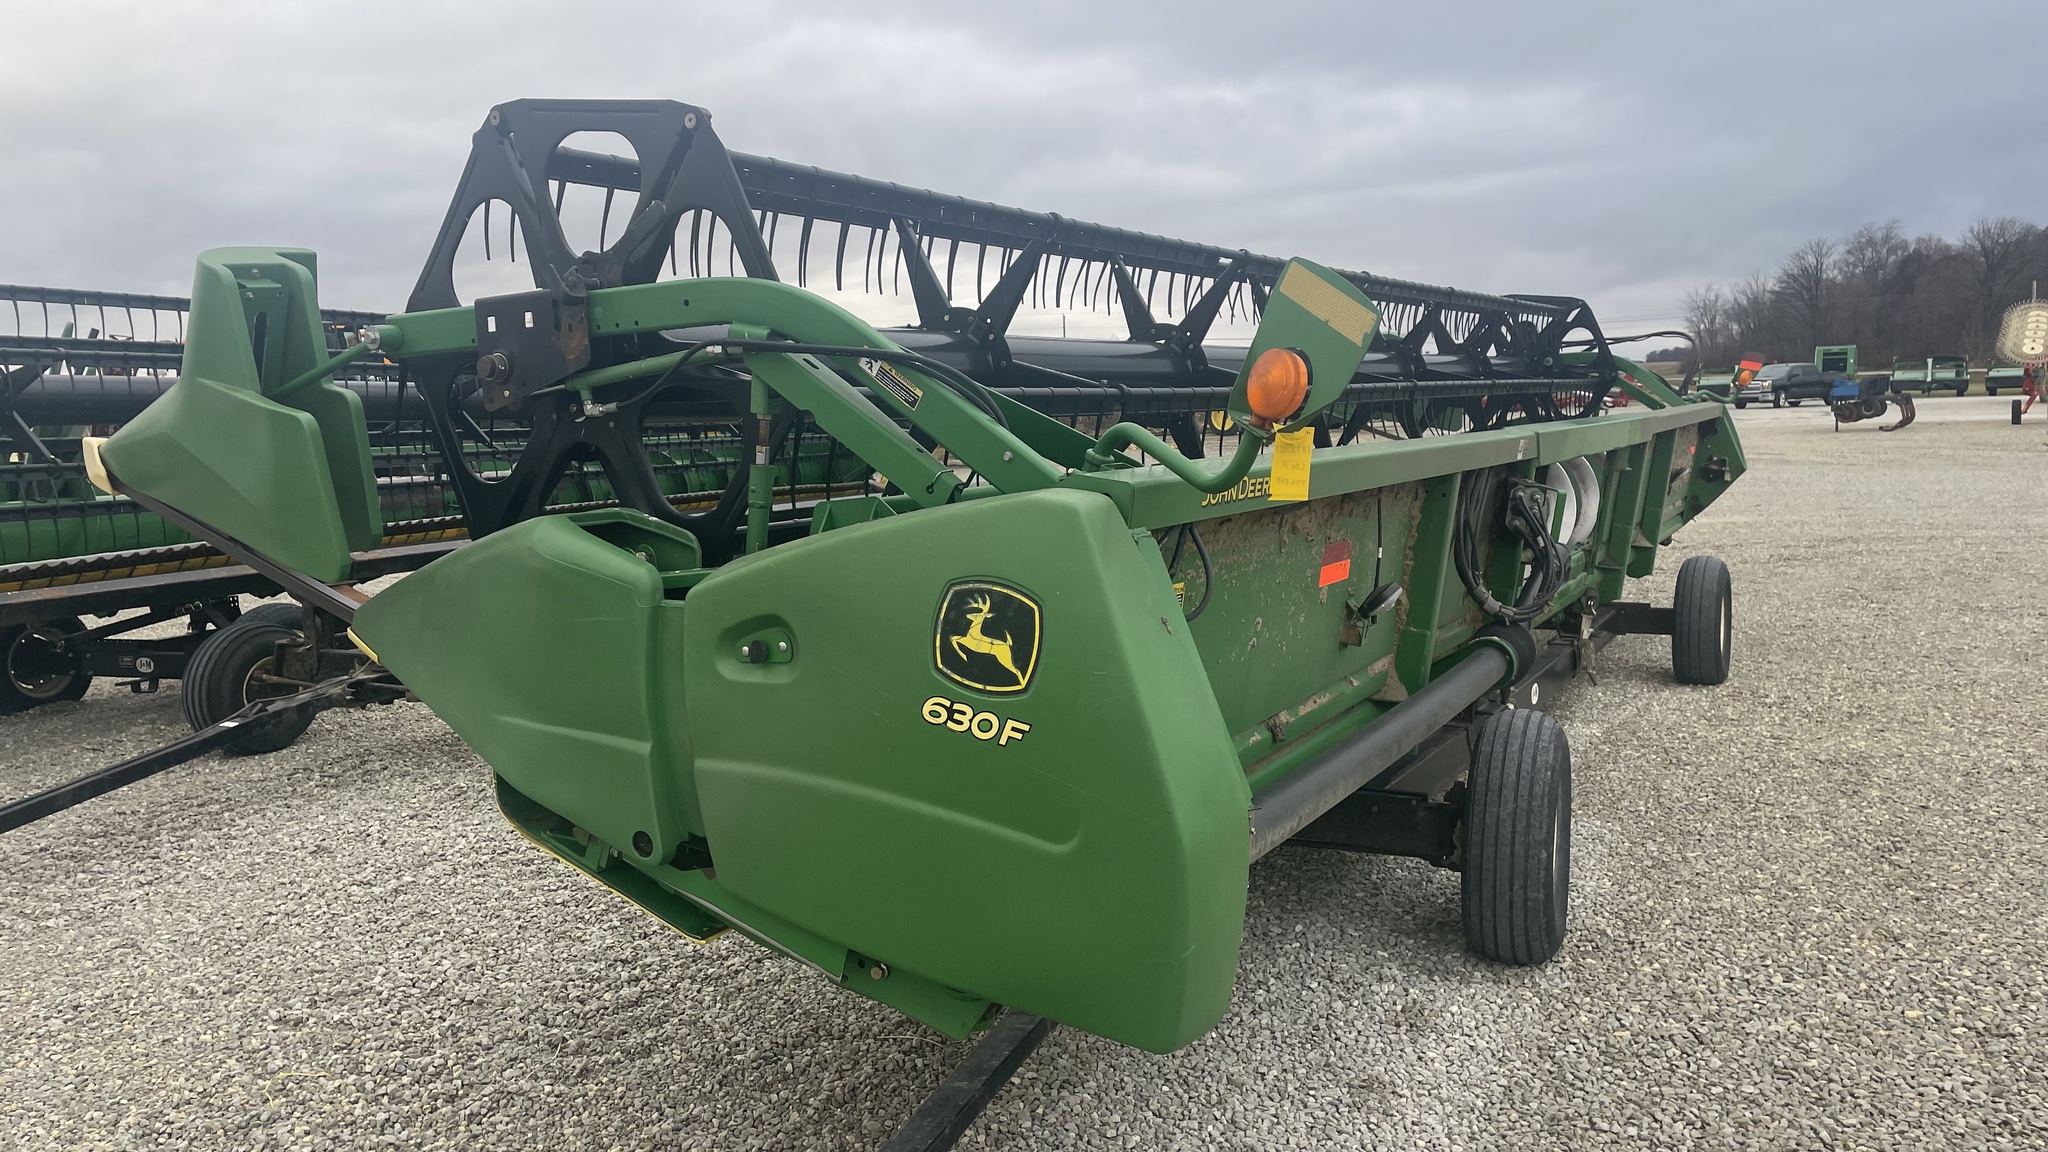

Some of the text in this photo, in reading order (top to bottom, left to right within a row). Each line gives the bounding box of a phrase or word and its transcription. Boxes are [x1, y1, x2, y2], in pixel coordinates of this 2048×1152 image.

[895, 371, 917, 391] WARNING
[1238, 475, 1271, 500] DEER
[921, 696, 1032, 747] 630F
